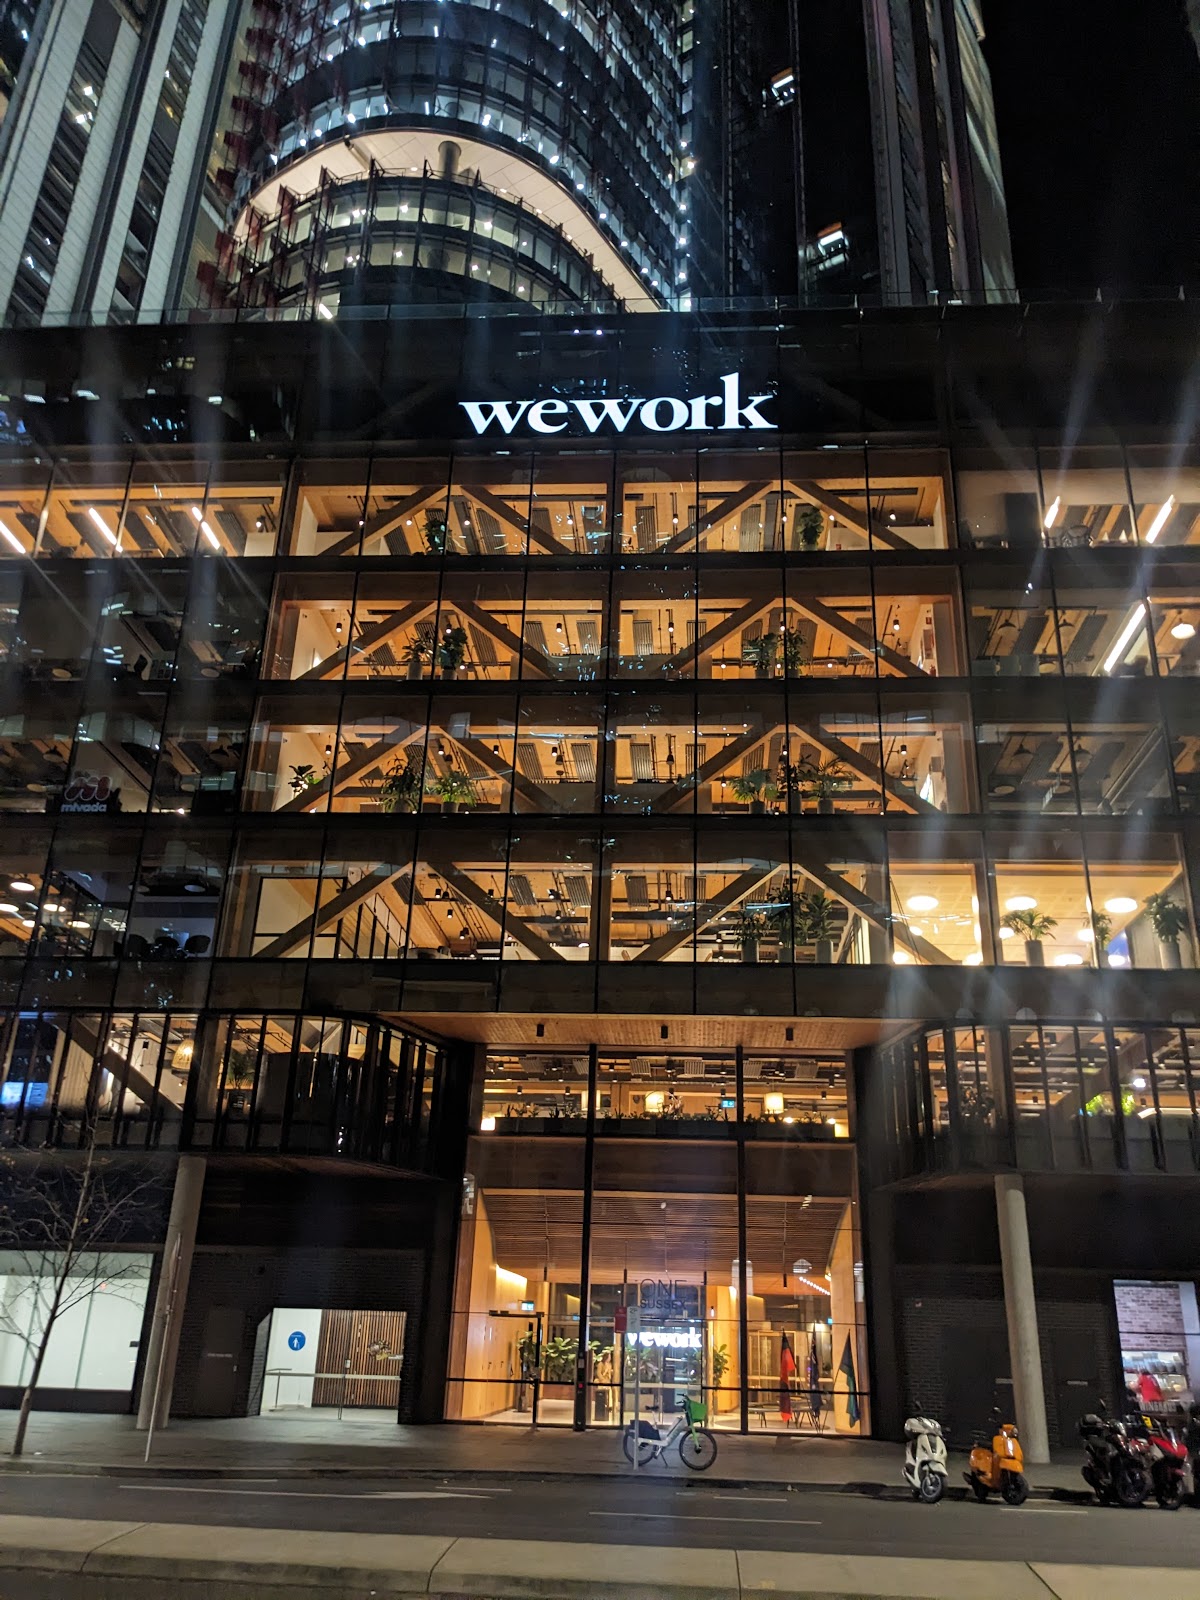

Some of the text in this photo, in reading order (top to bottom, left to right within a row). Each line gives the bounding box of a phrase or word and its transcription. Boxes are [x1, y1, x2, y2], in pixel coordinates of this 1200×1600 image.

[459, 372, 778, 434] wework
[640, 1278, 687, 1298] ONE
[640, 1299, 687, 1309] SUSSEX
